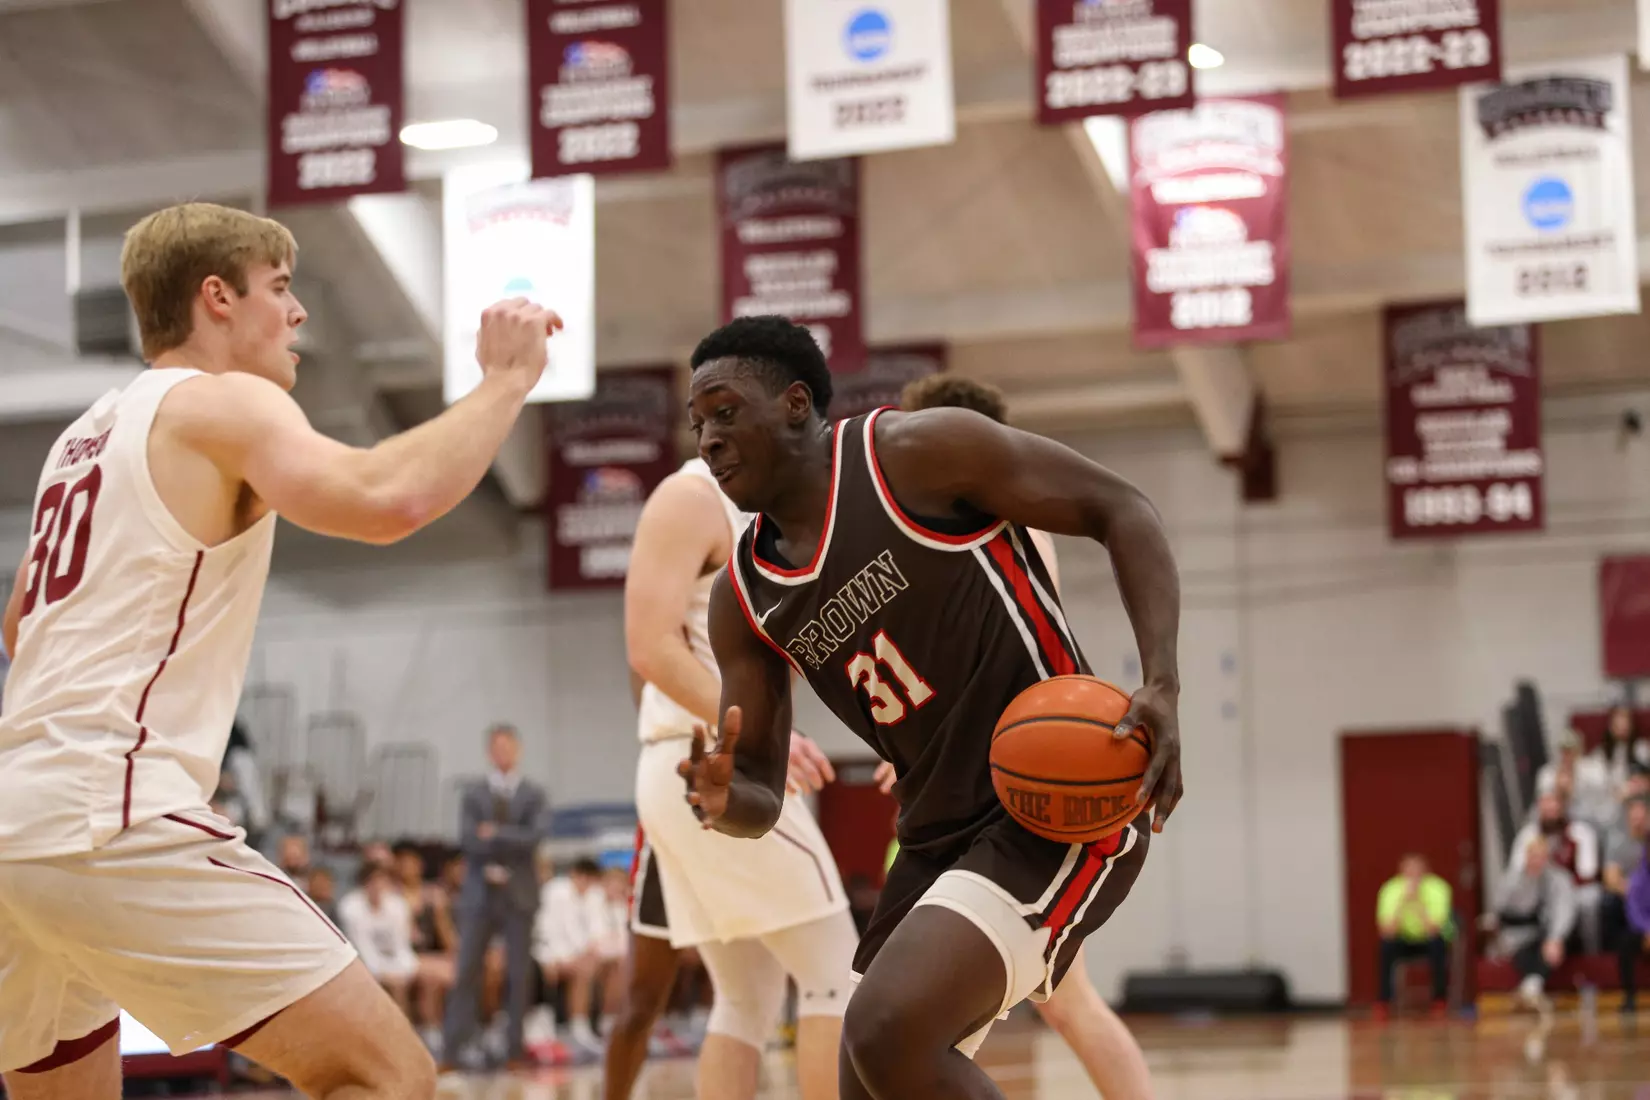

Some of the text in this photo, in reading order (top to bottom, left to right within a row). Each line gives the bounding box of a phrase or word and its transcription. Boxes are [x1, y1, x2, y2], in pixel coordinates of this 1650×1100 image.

[20, 464, 102, 617] 30
[786, 549, 910, 671] BROWN
[845, 628, 937, 726] 31
[1007, 786, 1052, 824] THE
